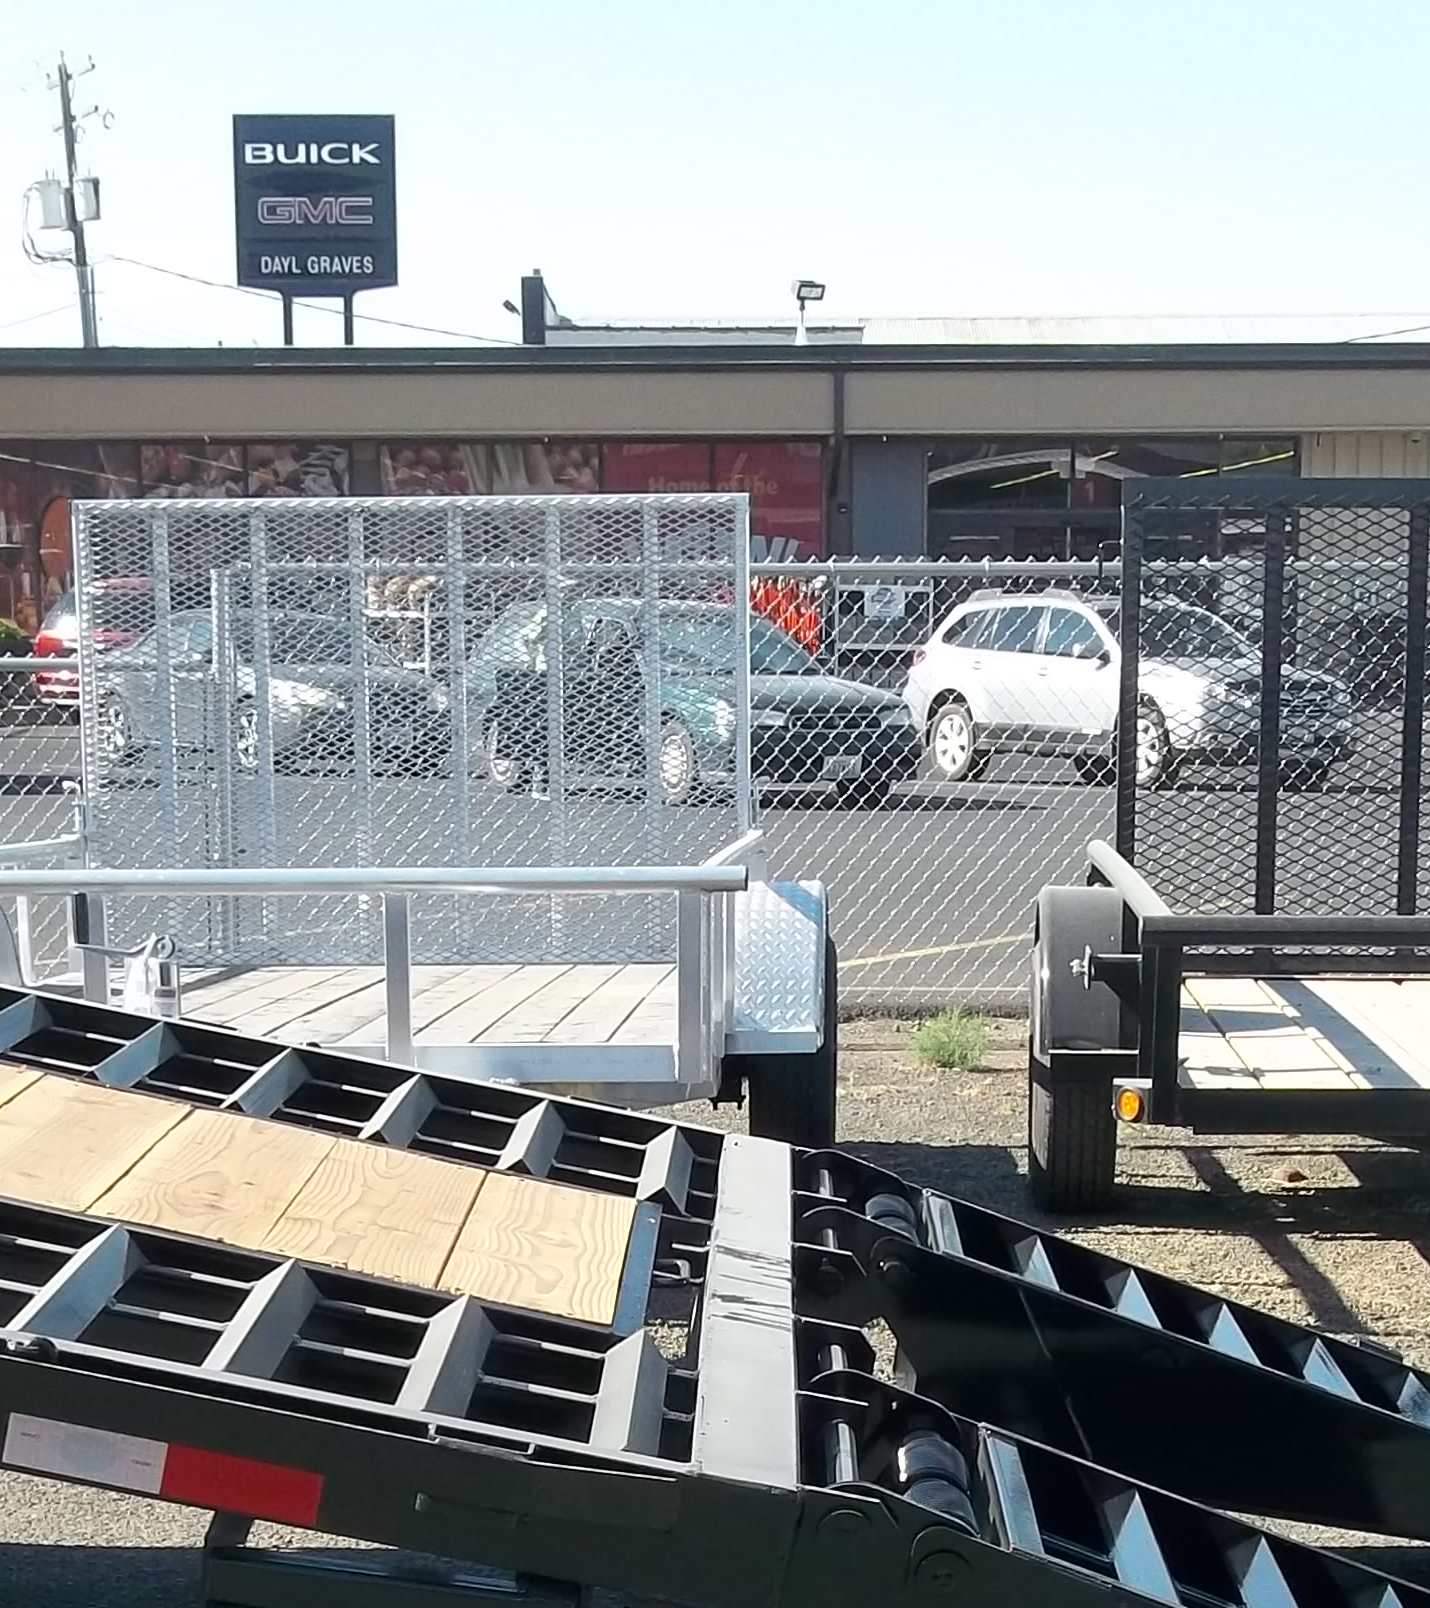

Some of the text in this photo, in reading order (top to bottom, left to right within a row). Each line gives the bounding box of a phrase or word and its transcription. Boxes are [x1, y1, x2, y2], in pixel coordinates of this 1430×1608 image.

[244, 143, 380, 164] BUICK
[258, 197, 373, 224] GMC
[261, 256, 373, 274] DAYL GRAVES
[648, 476, 710, 492] Home
[743, 475, 779, 494] the
